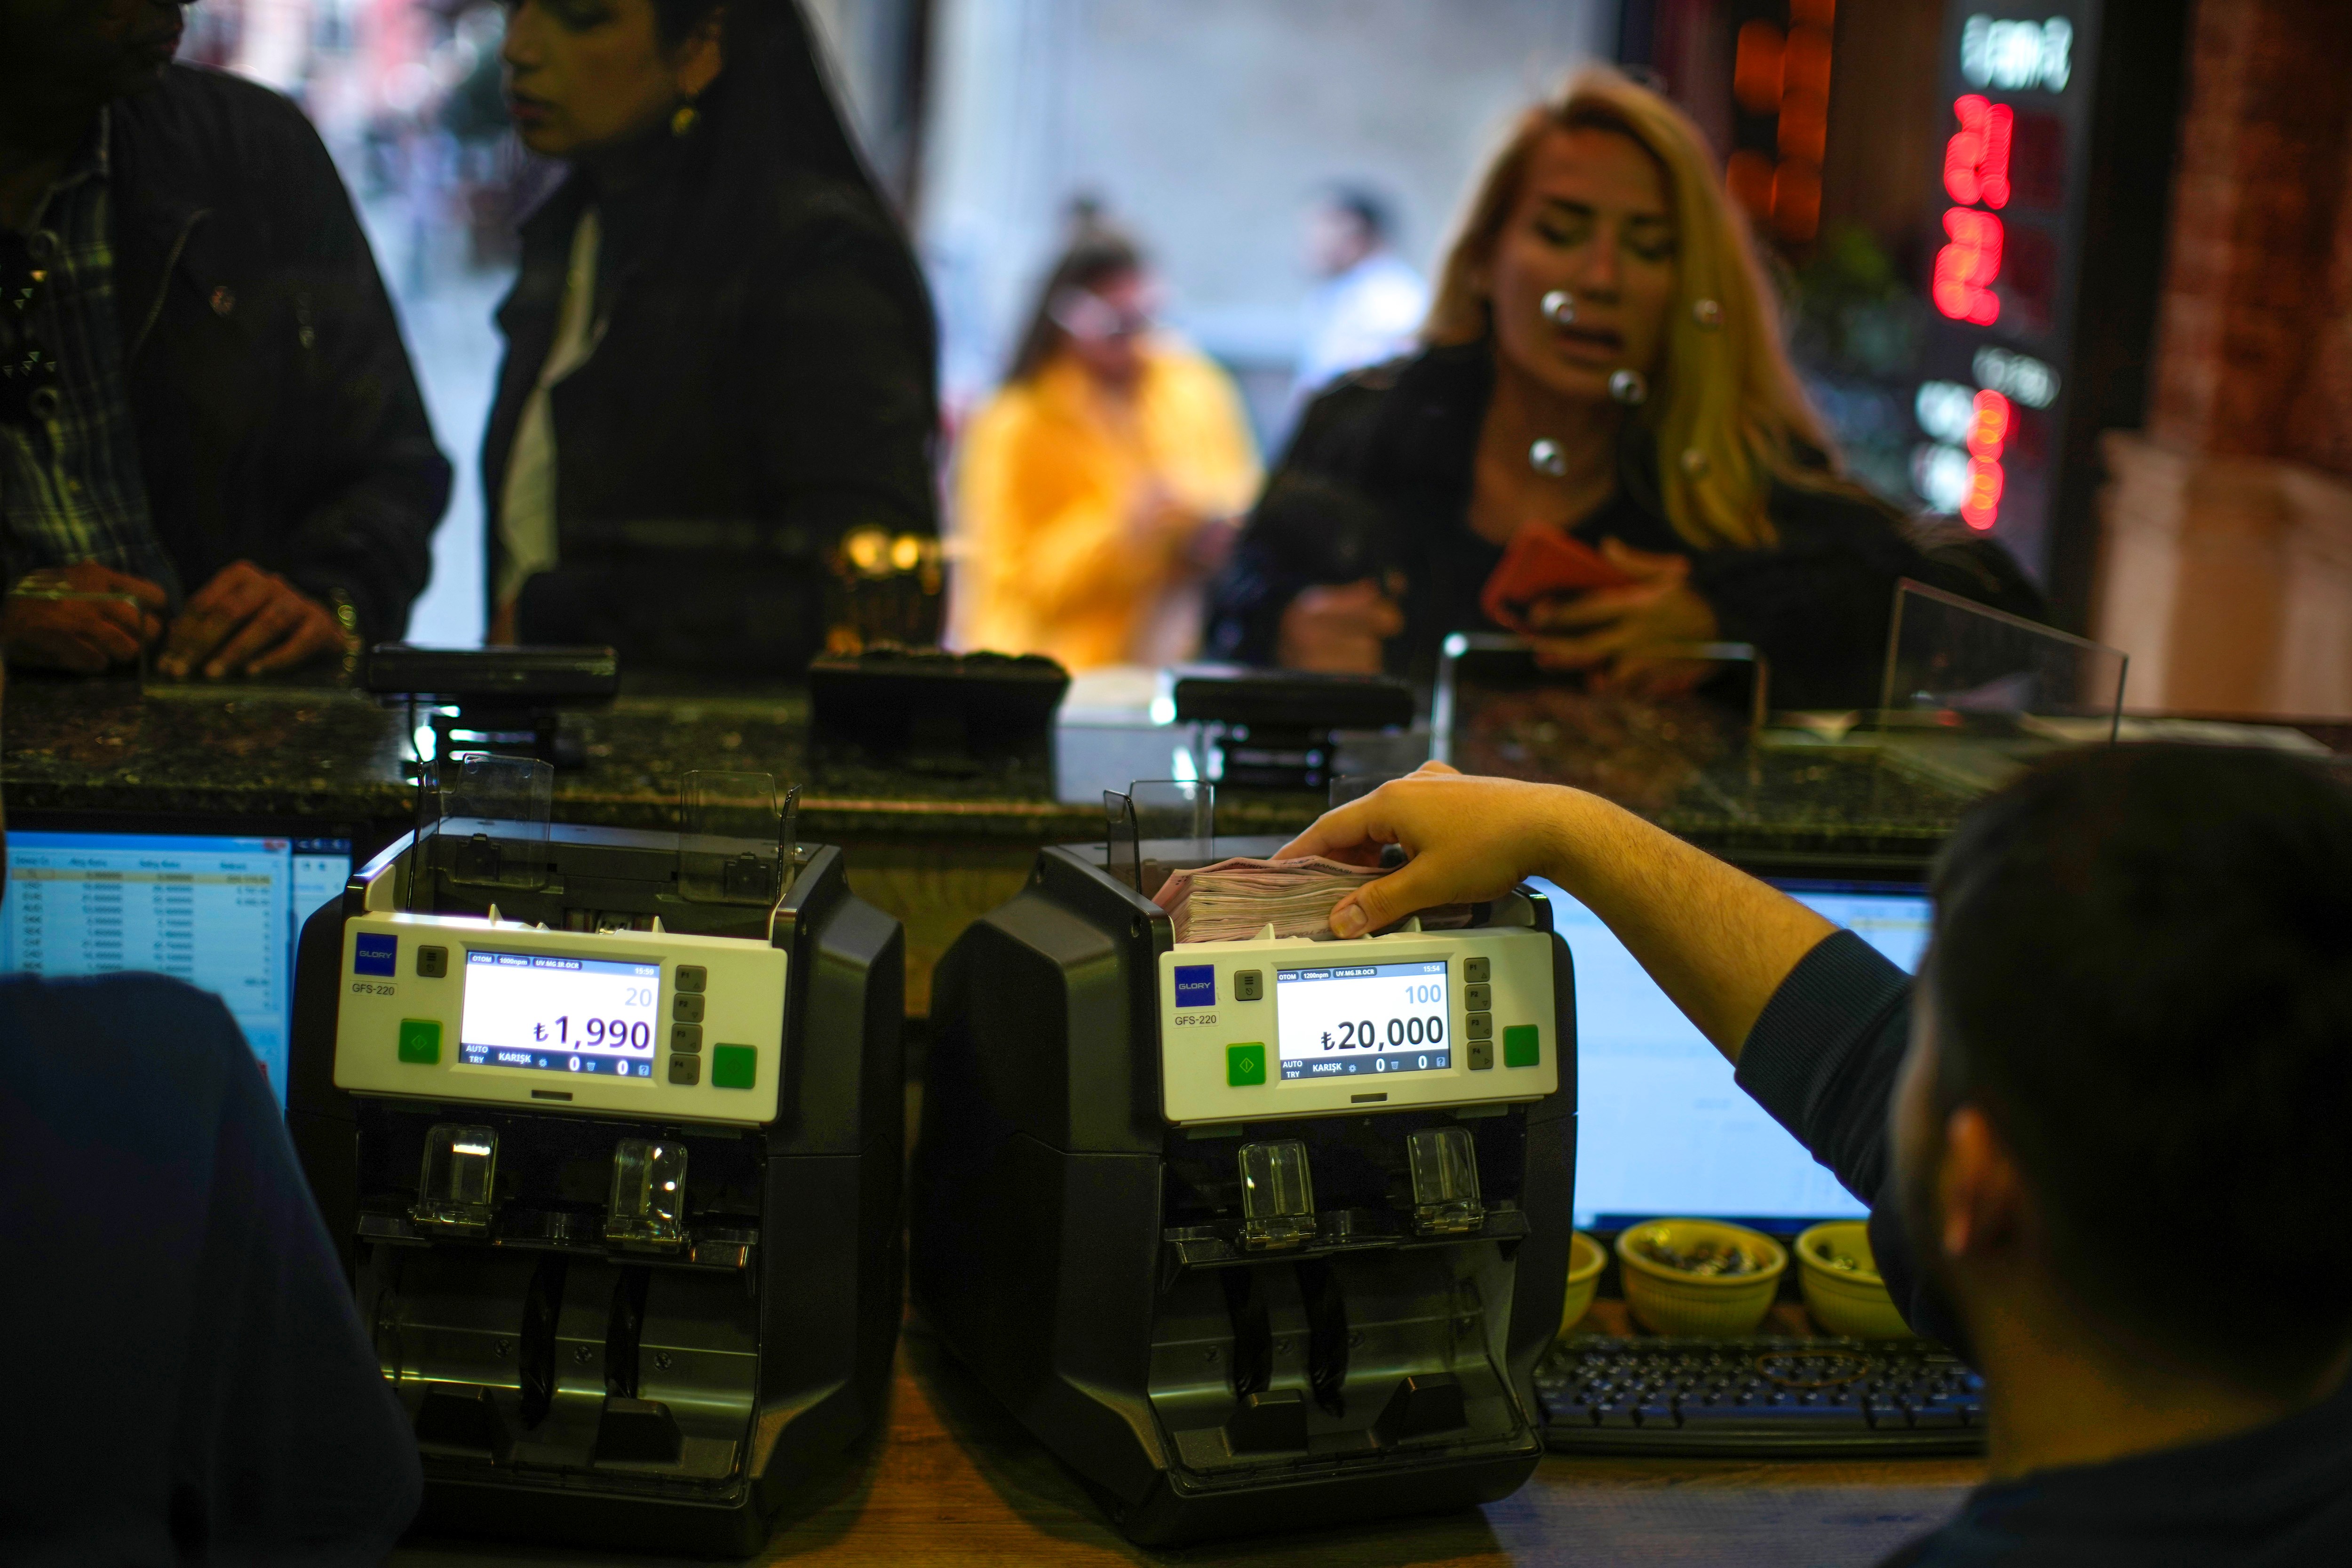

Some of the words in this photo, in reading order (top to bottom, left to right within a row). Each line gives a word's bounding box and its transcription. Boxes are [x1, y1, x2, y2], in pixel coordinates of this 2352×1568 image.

[499, 957, 528, 965] 1000npm
[352, 983, 395, 995] GFS-220
[625, 987, 652, 1007] 20
[1405, 984, 1441, 1004] 100
[1175, 1015, 1216, 1026] GFS-220
[499, 1052, 531, 1065] KARIŞK
[569, 1056, 580, 1072] 0
[618, 1060, 628, 1075] 0
[1313, 1062, 1342, 1073] KARIŞK
[1375, 1058, 1385, 1072] 0
[1418, 1055, 1428, 1069] 0
